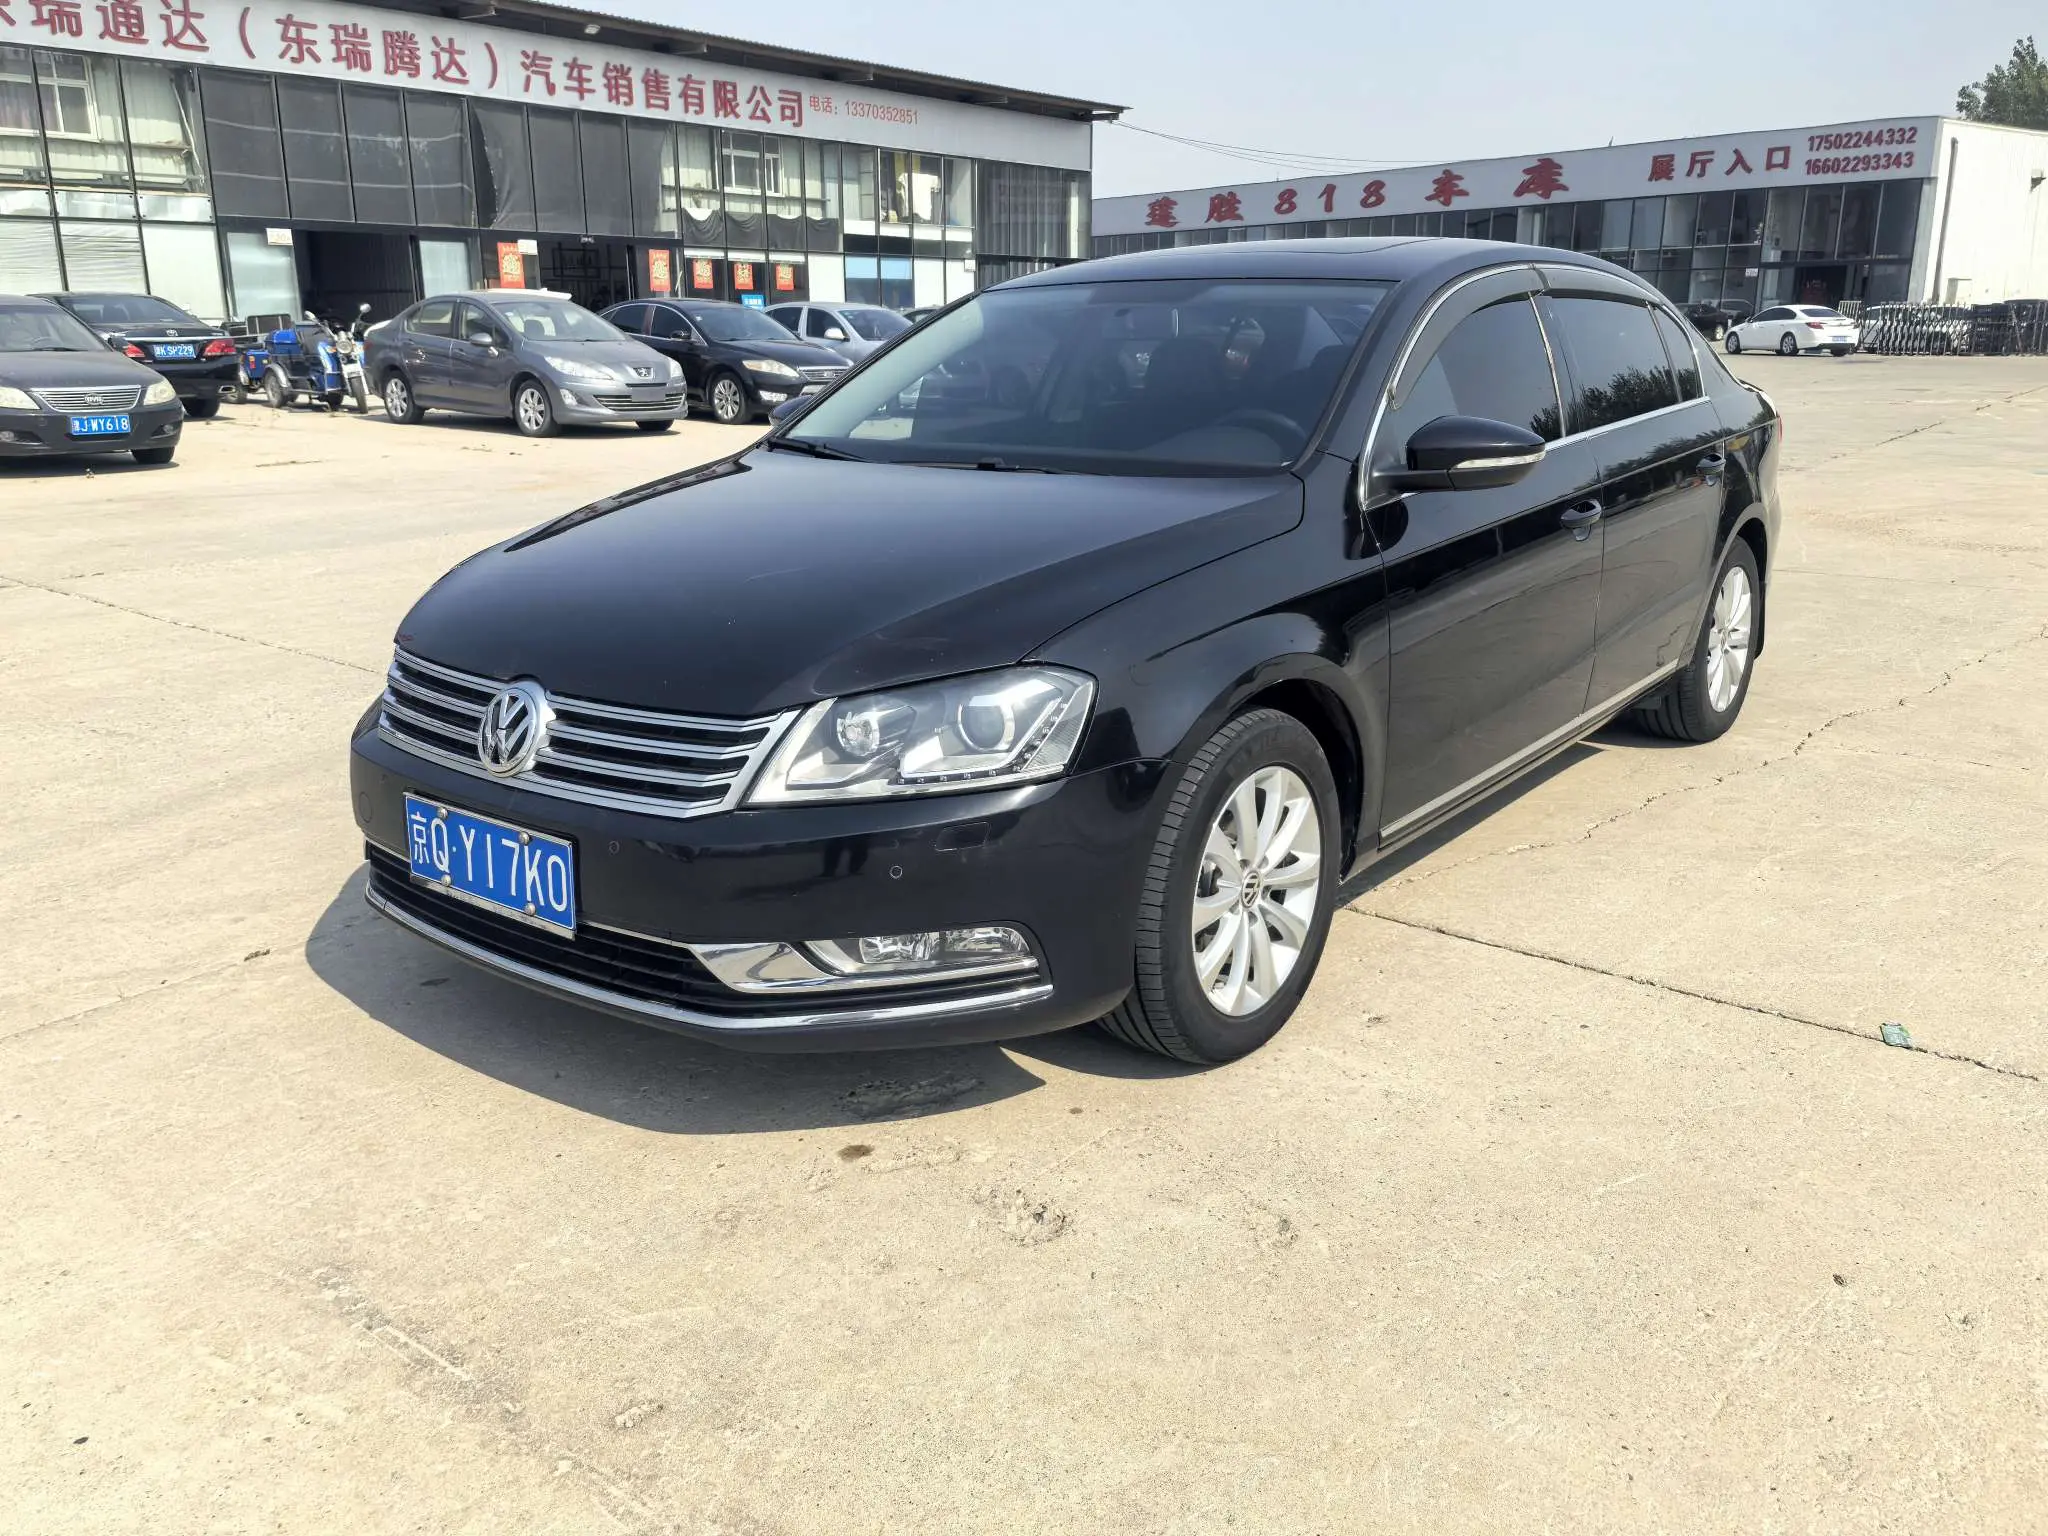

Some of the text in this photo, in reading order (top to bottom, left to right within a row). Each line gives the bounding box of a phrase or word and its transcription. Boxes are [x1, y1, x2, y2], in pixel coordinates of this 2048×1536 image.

[0, 0, 803, 128] 瑞通达（东瑞腾达）汽车销售有限公司
[1806, 126, 1918, 152] 17502244332
[1648, 146, 1792, 182] 展厅入口
[1804, 151, 1915, 176] 16602293343
